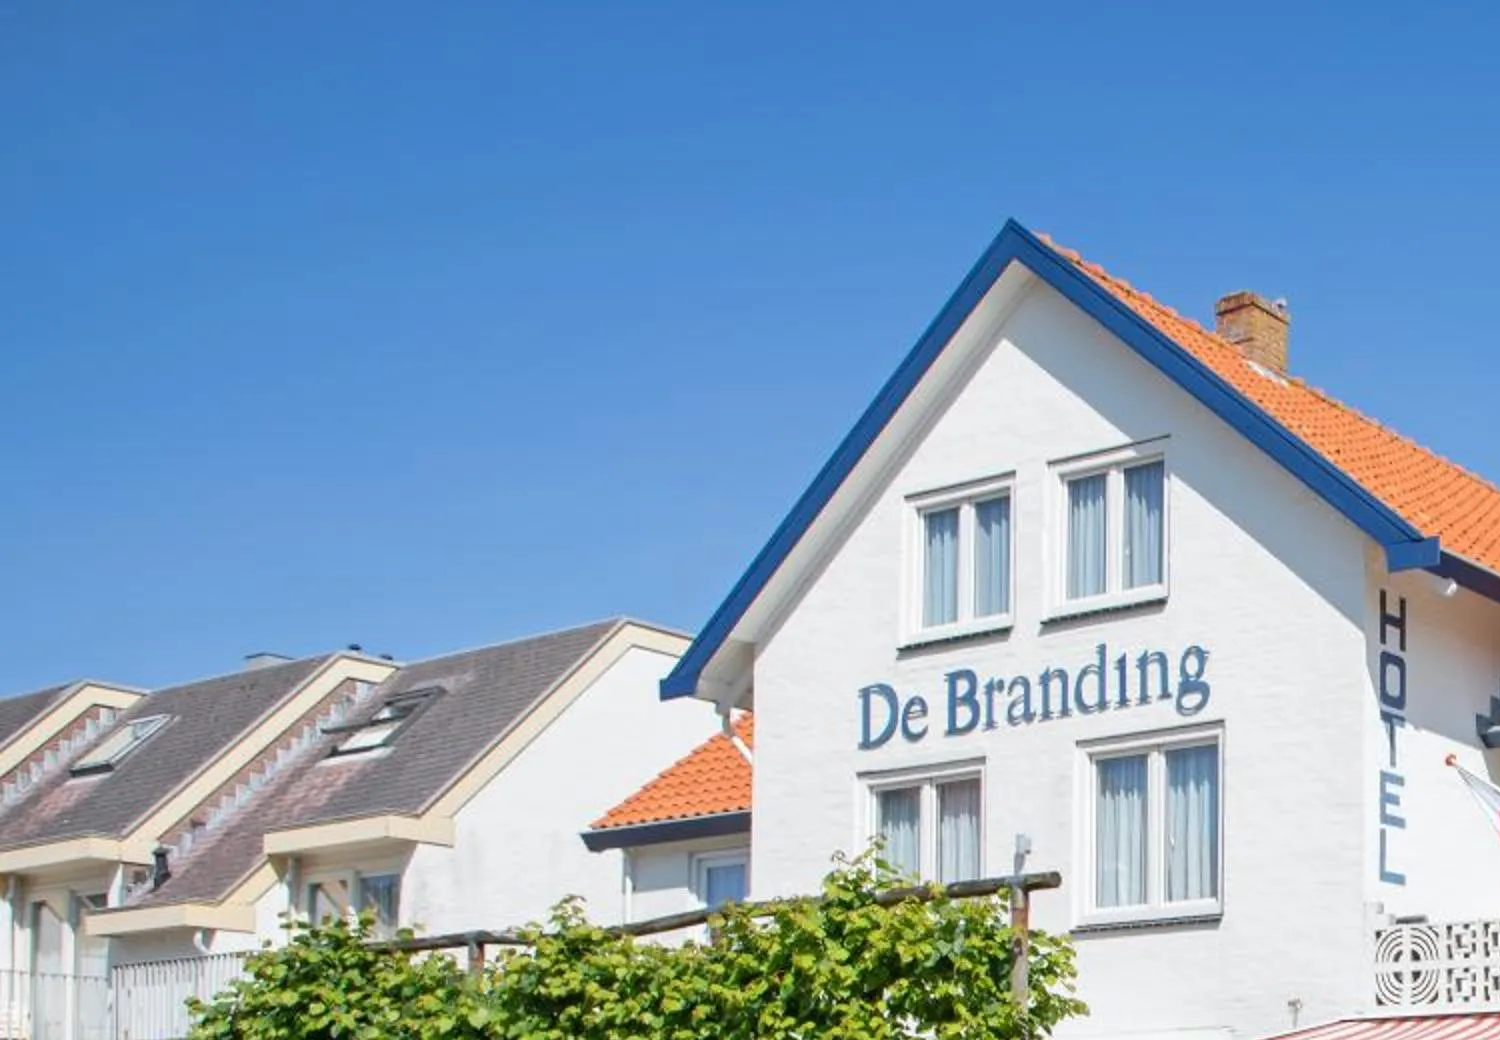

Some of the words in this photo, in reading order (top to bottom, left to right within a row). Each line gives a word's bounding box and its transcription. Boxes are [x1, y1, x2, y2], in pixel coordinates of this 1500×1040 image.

[858, 682, 929, 751] De
[943, 642, 1211, 738] Branding
[1380, 589, 1406, 886] HOTEL
